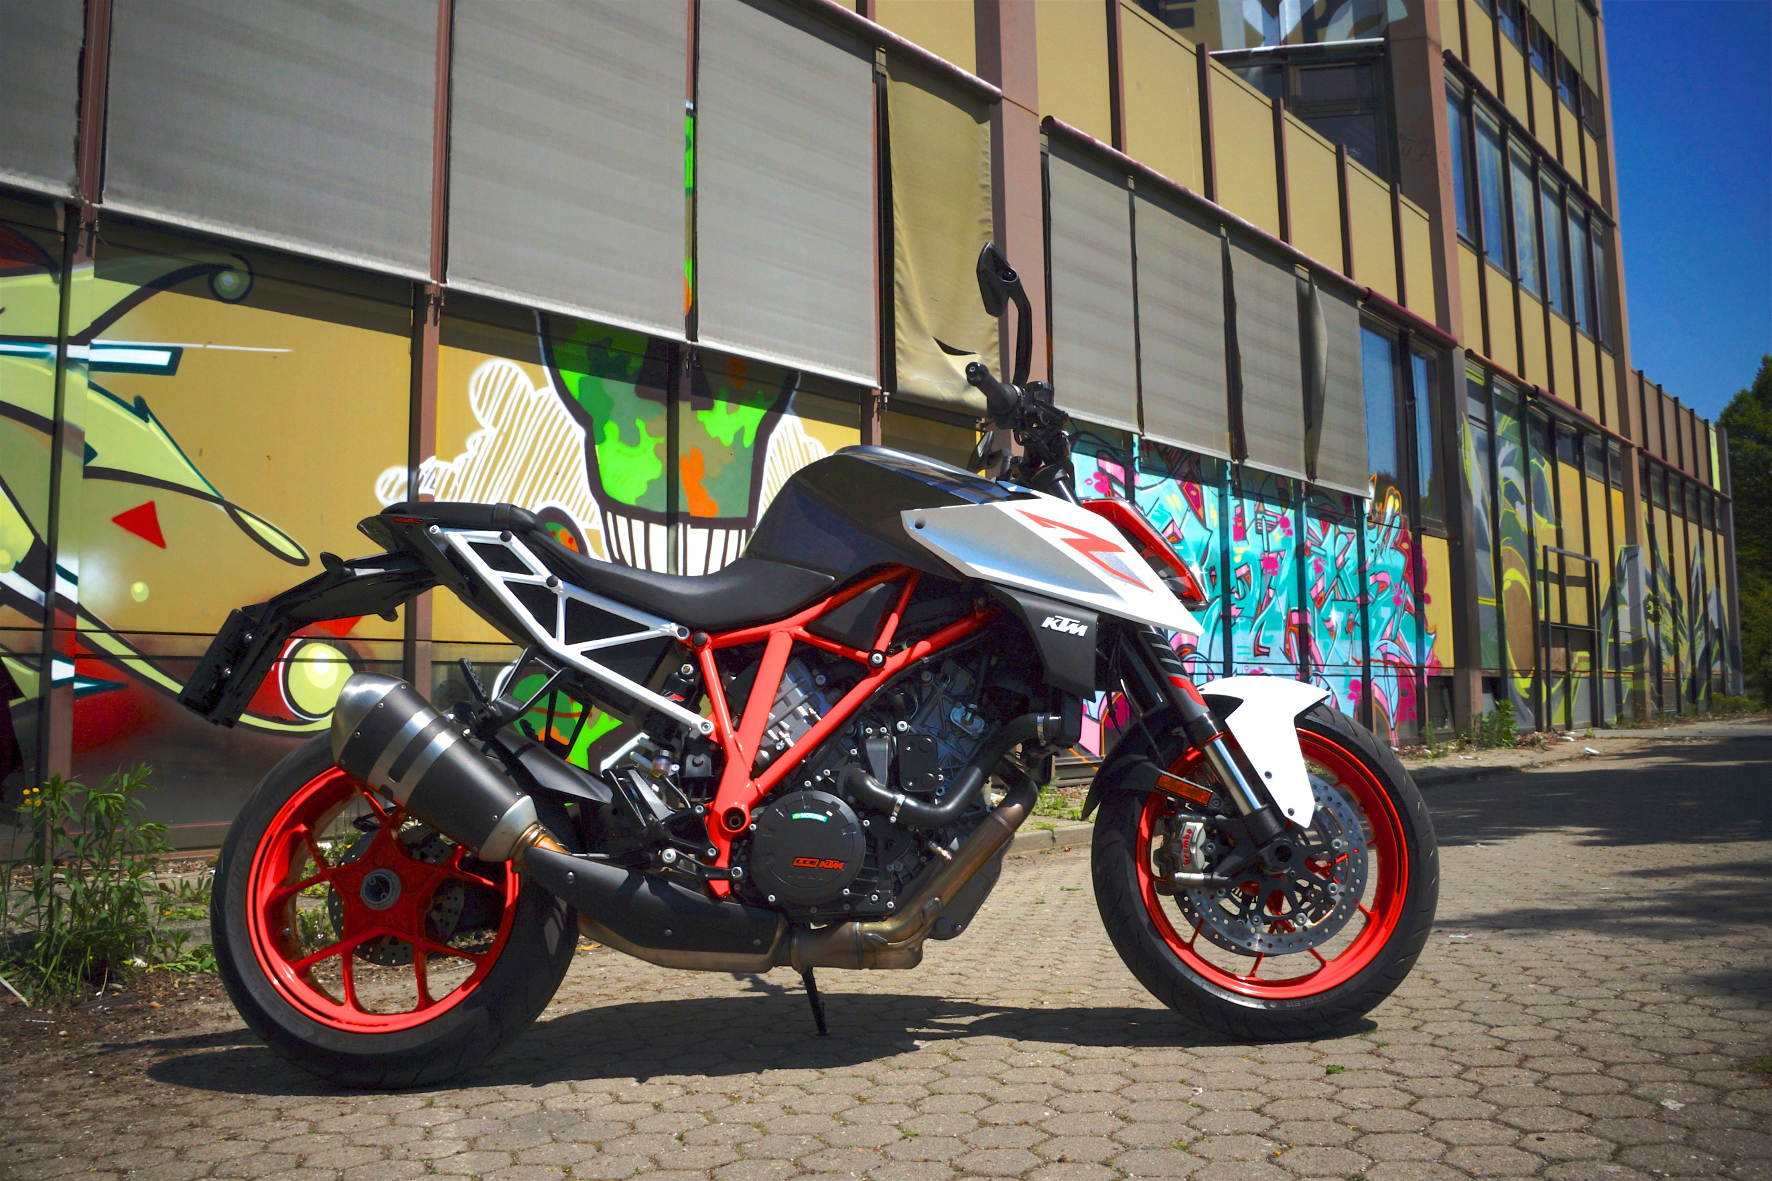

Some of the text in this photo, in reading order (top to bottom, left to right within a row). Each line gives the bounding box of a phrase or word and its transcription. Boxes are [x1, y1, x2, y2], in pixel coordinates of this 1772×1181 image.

[1041, 615, 1089, 637] KTM
[1182, 828, 1193, 867] brembo
[818, 859, 845, 870] KTM
[1286, 987, 1344, 1008] METZELER
